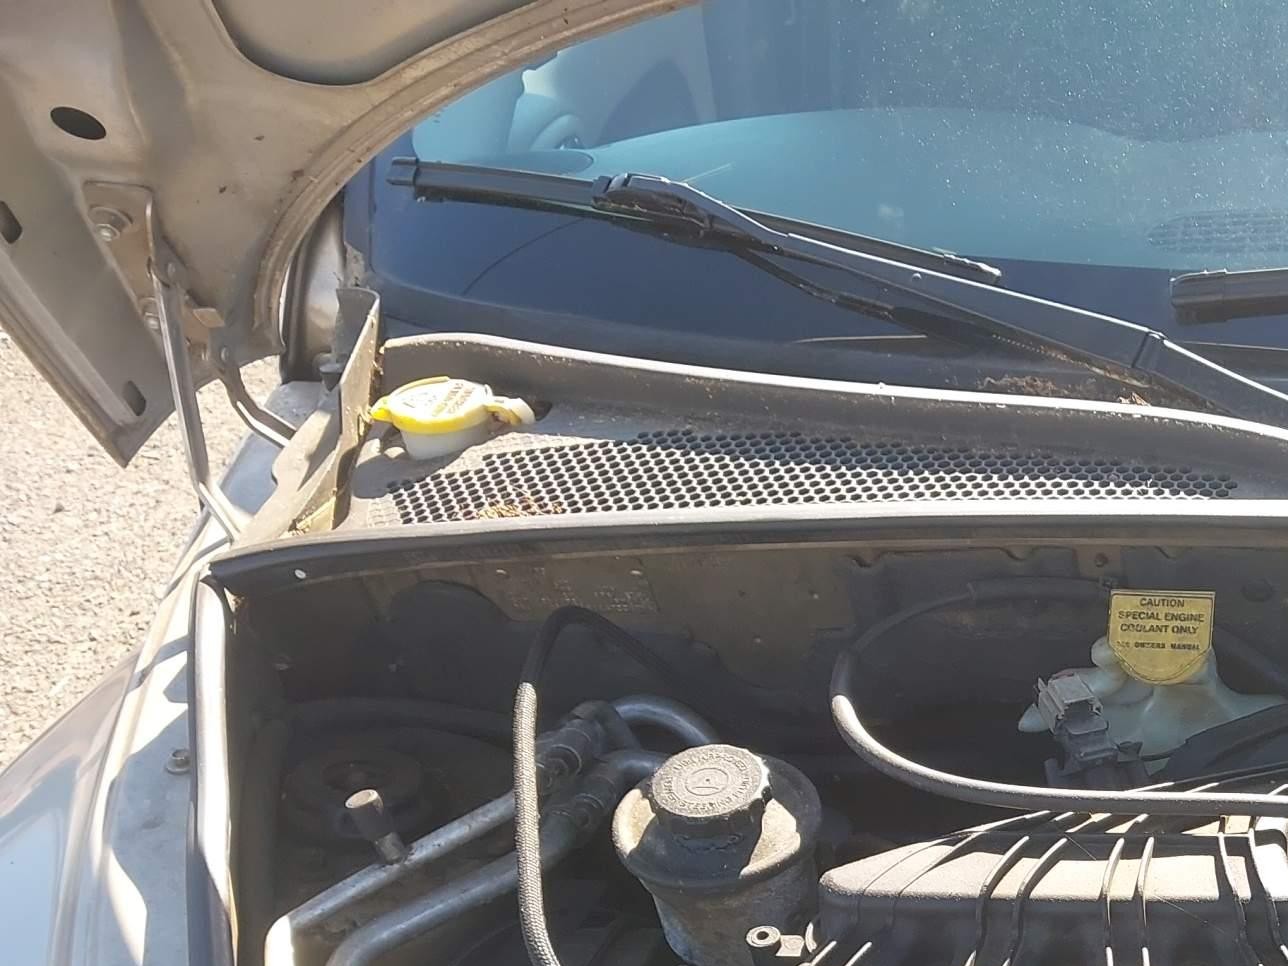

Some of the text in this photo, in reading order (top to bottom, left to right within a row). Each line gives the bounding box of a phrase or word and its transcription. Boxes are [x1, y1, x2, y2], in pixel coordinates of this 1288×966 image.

[1140, 598, 1184, 608] CAUTION
[1118, 611, 1205, 622] SPECIAL ENGINE
[1120, 624, 1199, 634] COOLANT ONLY
